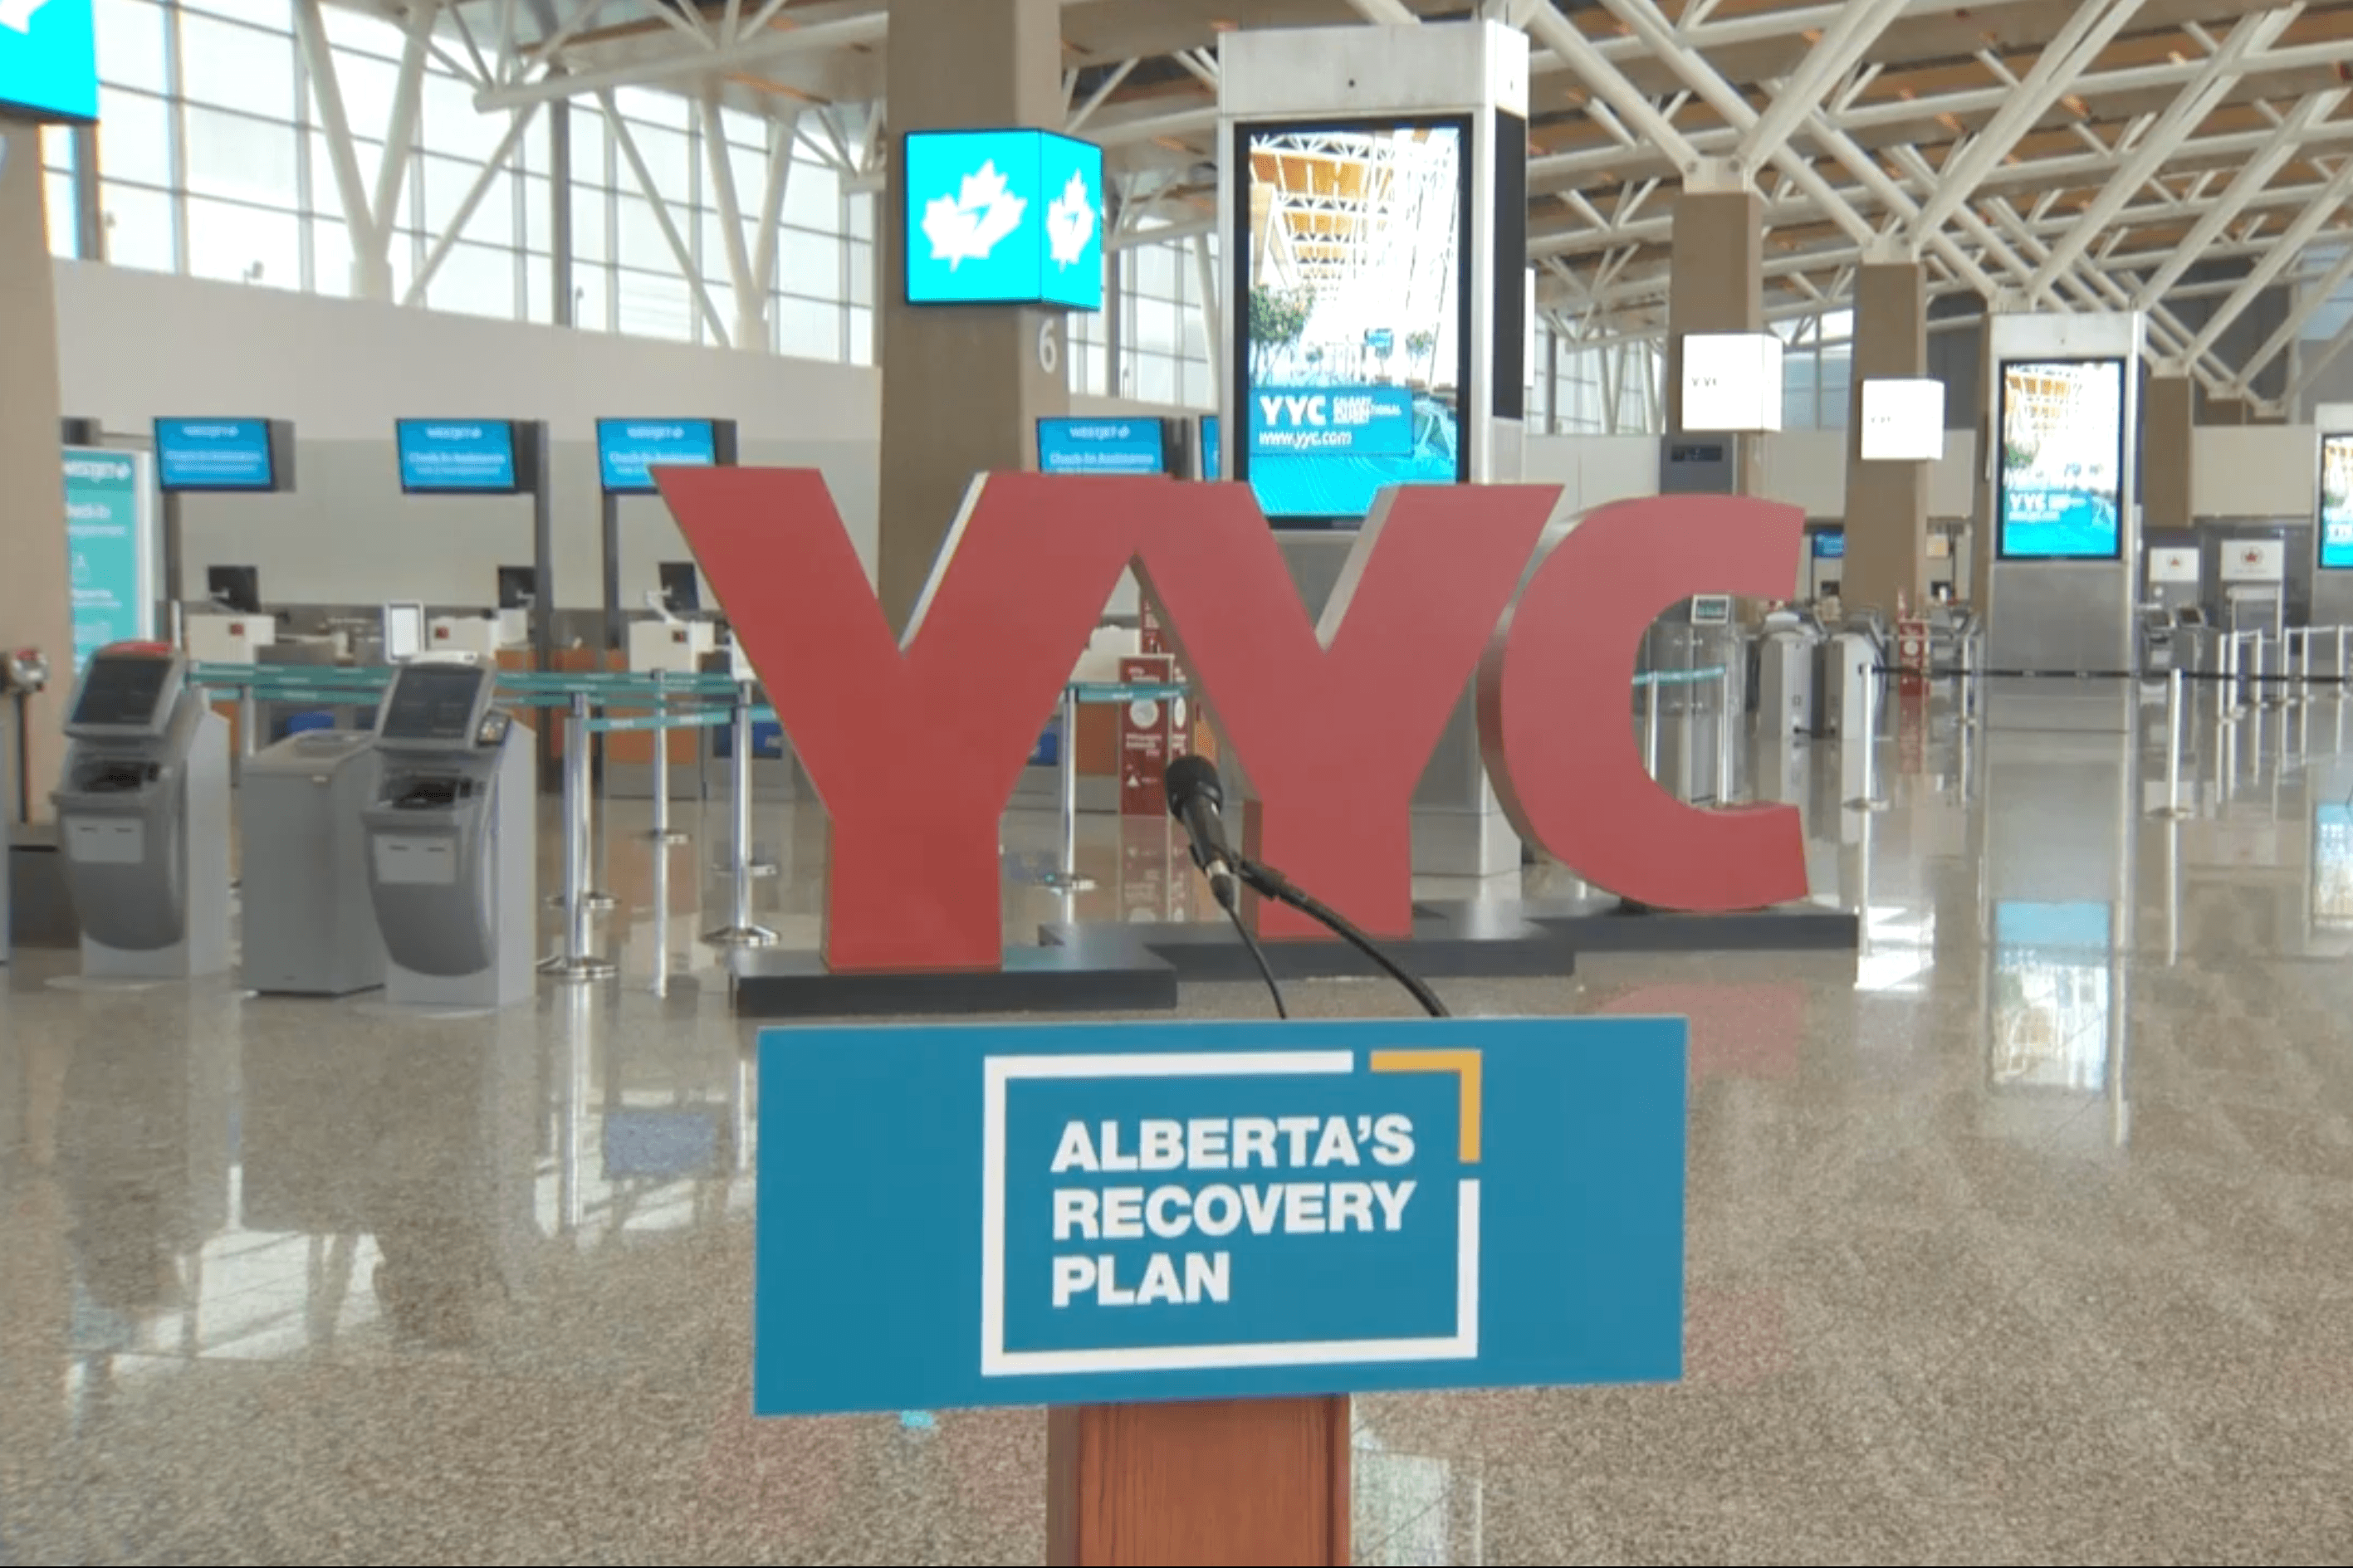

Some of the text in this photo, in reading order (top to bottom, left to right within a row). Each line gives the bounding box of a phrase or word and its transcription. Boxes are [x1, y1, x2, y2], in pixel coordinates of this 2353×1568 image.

[1039, 317, 1058, 374] 6
[1259, 394, 1327, 427] YYC
[1259, 431, 1353, 451] www.yyc.com
[649, 465, 1808, 975] YYC
[1050, 1114, 1416, 1174] ALBERTA'S
[1052, 1180, 1417, 1241] RECOVERY
[1052, 1252, 1231, 1308] PLAN
